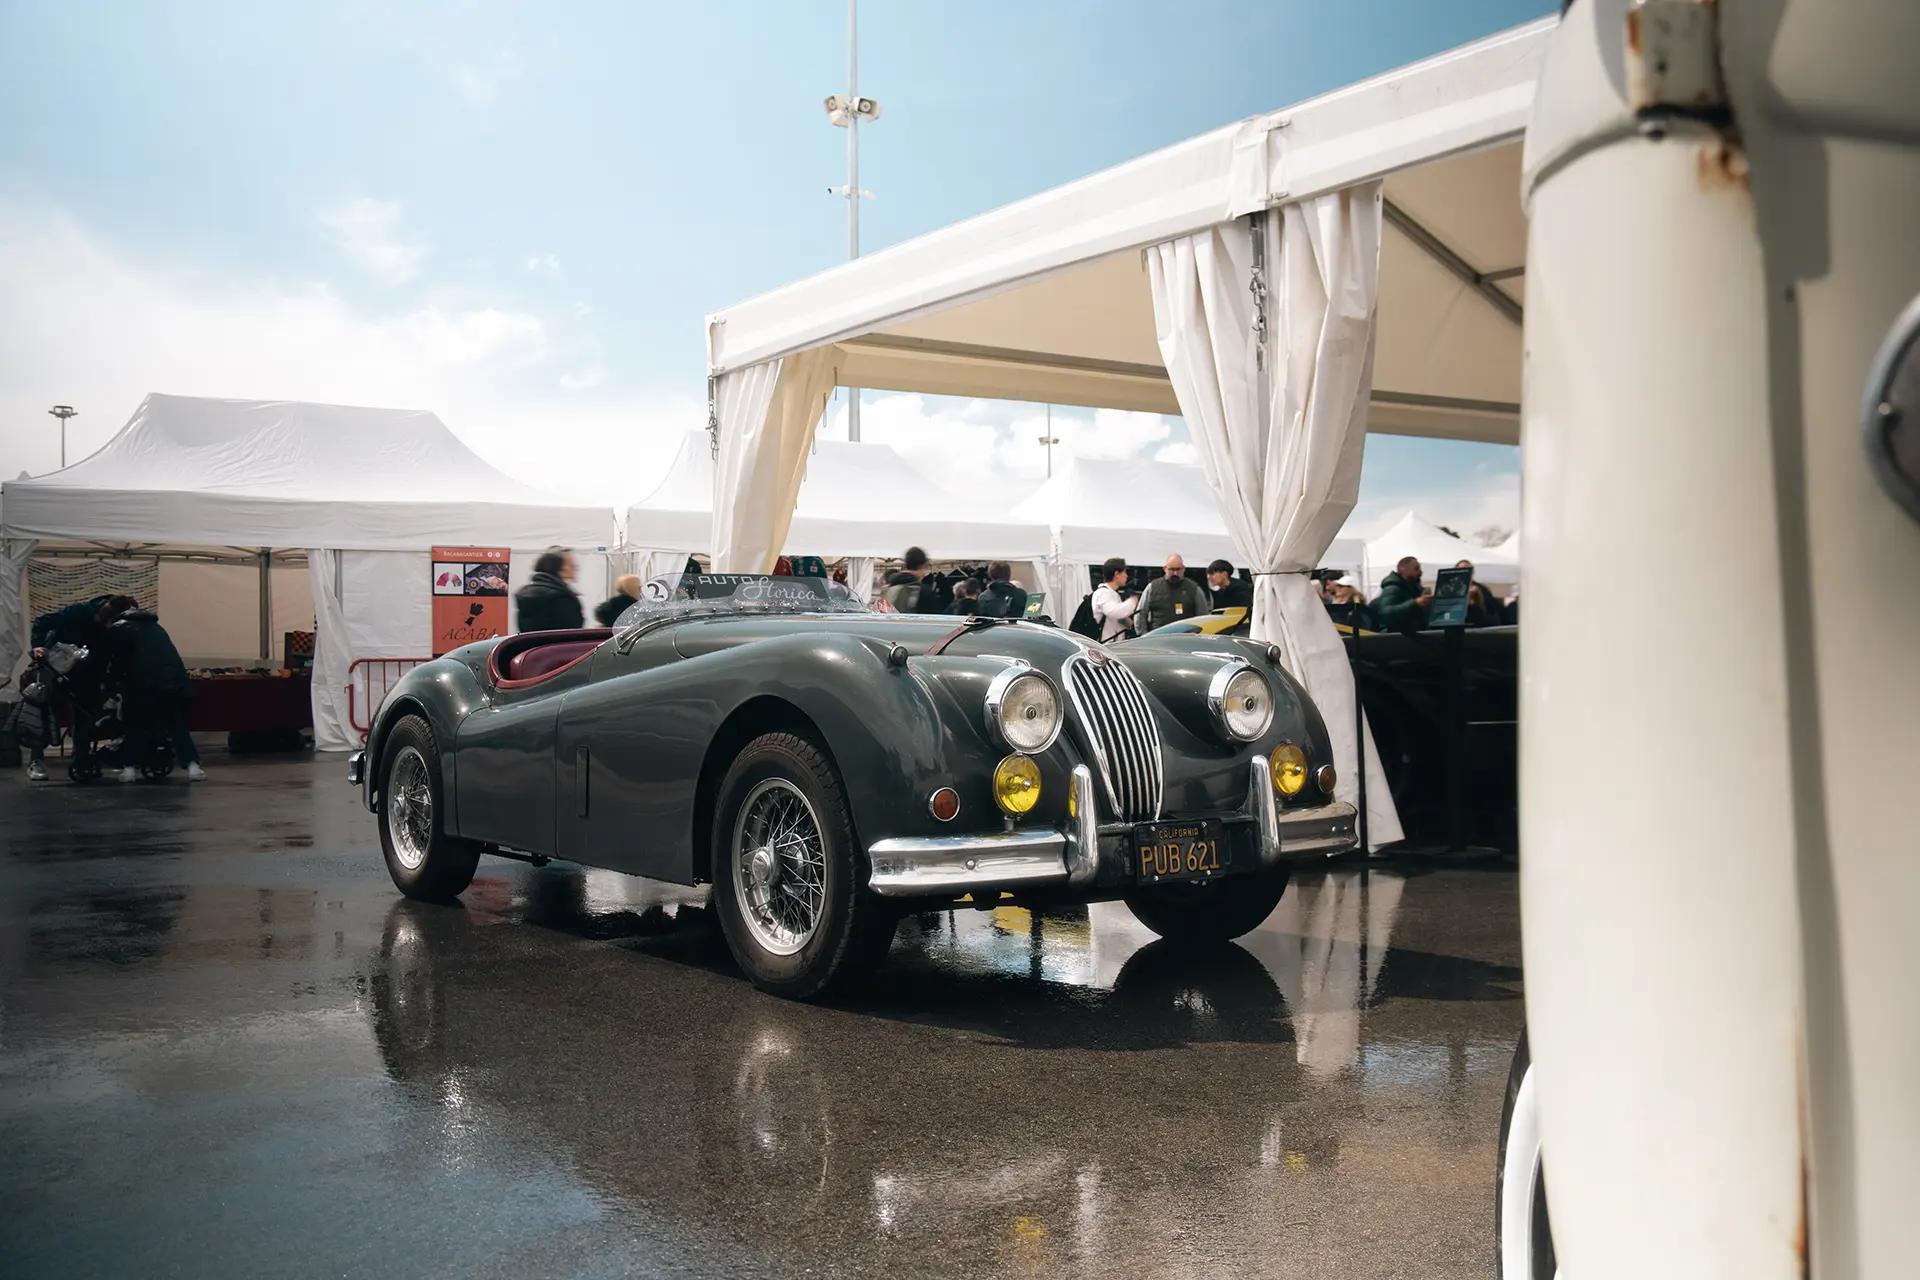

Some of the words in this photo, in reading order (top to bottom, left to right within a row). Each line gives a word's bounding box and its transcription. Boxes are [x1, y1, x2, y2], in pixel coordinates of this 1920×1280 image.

[698, 575, 755, 585] AUTO
[742, 576, 817, 600] Storica
[646, 583, 665, 599] 2
[1159, 827, 1199, 839] CALIFORNIA
[1140, 843, 1181, 876] PUB
[1187, 839, 1220, 872] 621
